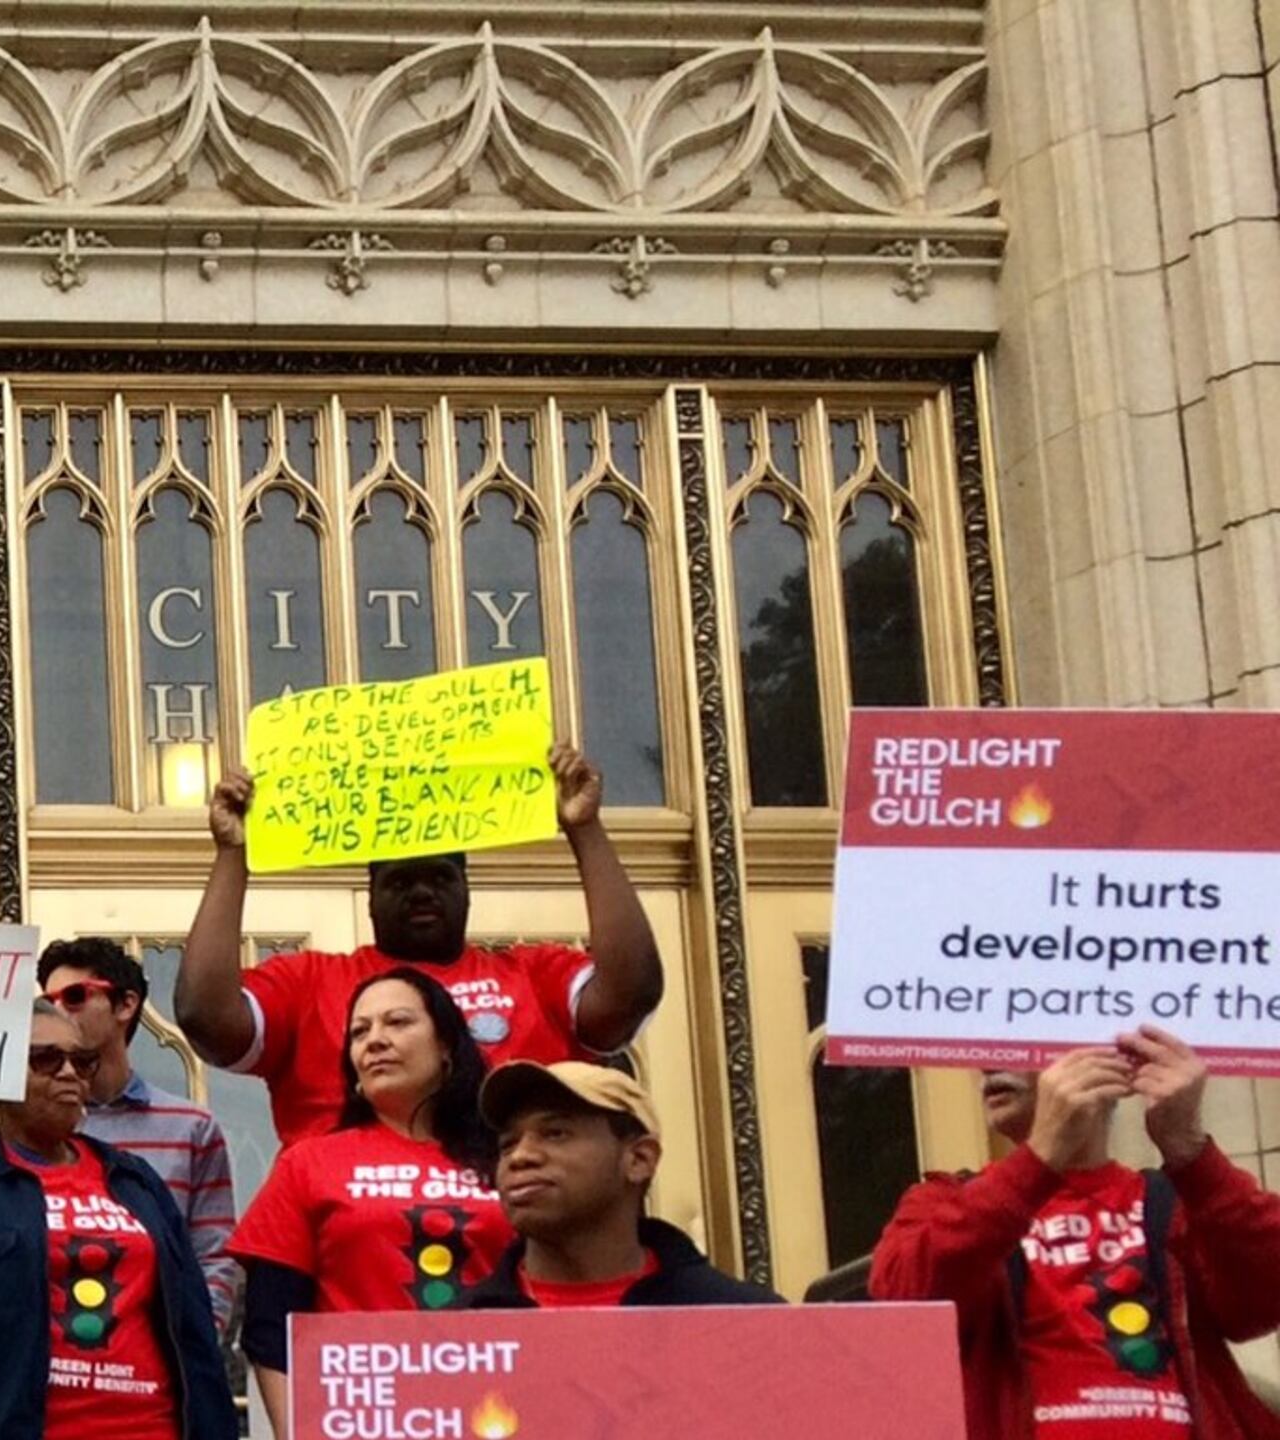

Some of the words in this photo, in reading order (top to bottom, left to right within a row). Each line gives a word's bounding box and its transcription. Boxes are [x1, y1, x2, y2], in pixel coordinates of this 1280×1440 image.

[149, 587, 531, 650] CITY
[148, 683, 213, 744] H
[268, 688, 353, 723] STOP
[361, 682, 415, 707] THE
[289, 743, 351, 769] ONLY
[363, 721, 494, 759] BENEFITS
[874, 738, 1061, 767] REDLIGHT
[277, 765, 370, 797] PEOPLE
[383, 752, 450, 781] LIKE
[873, 768, 942, 795] THE
[264, 792, 368, 825] ARTHUR
[378, 773, 484, 813] BLANK
[489, 767, 545, 797] AND
[869, 798, 1001, 827] GULCH
[304, 819, 361, 855] HIS
[1050, 872, 1080, 907] It
[1096, 873, 1221, 910] hurts
[940, 924, 1271, 970] development
[864, 977, 992, 1012] other
[1007, 984, 1134, 1023] parts
[1151, 982, 1201, 1019] of
[346, 1182, 414, 1199] THE
[353, 1165, 420, 1182] RED
[94, 1362, 135, 1377] LIGHT
[321, 1341, 520, 1374] REDLIGHT
[321, 1376, 395, 1407] THE
[321, 1408, 462, 1440] GULCH
[1034, 1402, 1158, 1423] COMMUNITY
